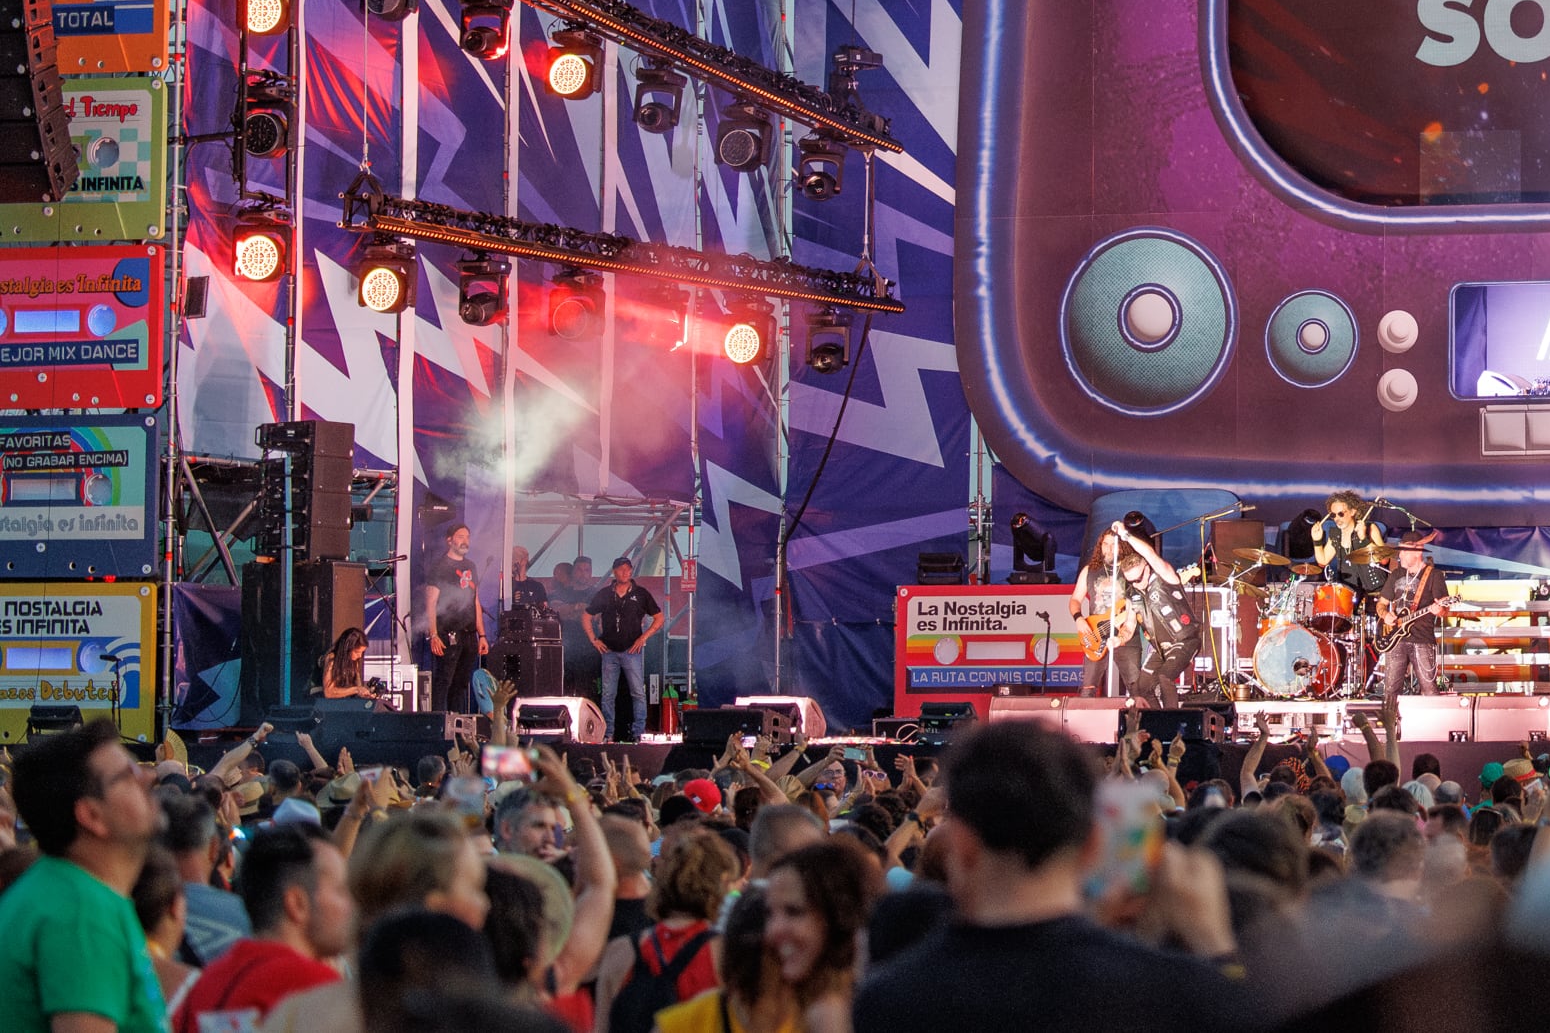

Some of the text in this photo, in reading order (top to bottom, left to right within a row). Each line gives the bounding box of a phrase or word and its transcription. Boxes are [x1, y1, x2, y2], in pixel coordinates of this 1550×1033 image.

[57, 11, 114, 28] TOTAL
[80, 95, 138, 123] Tiempo
[81, 175, 145, 191] INFINITA
[57, 274, 141, 294] es Infinita
[50, 346, 76, 361] MIX
[81, 343, 137, 359] DANCE
[3, 451, 128, 469] (NO GRABAR ENCIMA)
[58, 513, 139, 532] es infinita
[4, 601, 103, 616] NOSTALGIA
[917, 601, 1027, 618] La Nostalgia
[16, 619, 90, 635] INFINITA
[917, 616, 1008, 631] es Infinita.
[913, 671, 928, 683] LA
[931, 671, 966, 683] RUTA
[969, 671, 997, 682] CON
[1000, 671, 1022, 683] MIS
